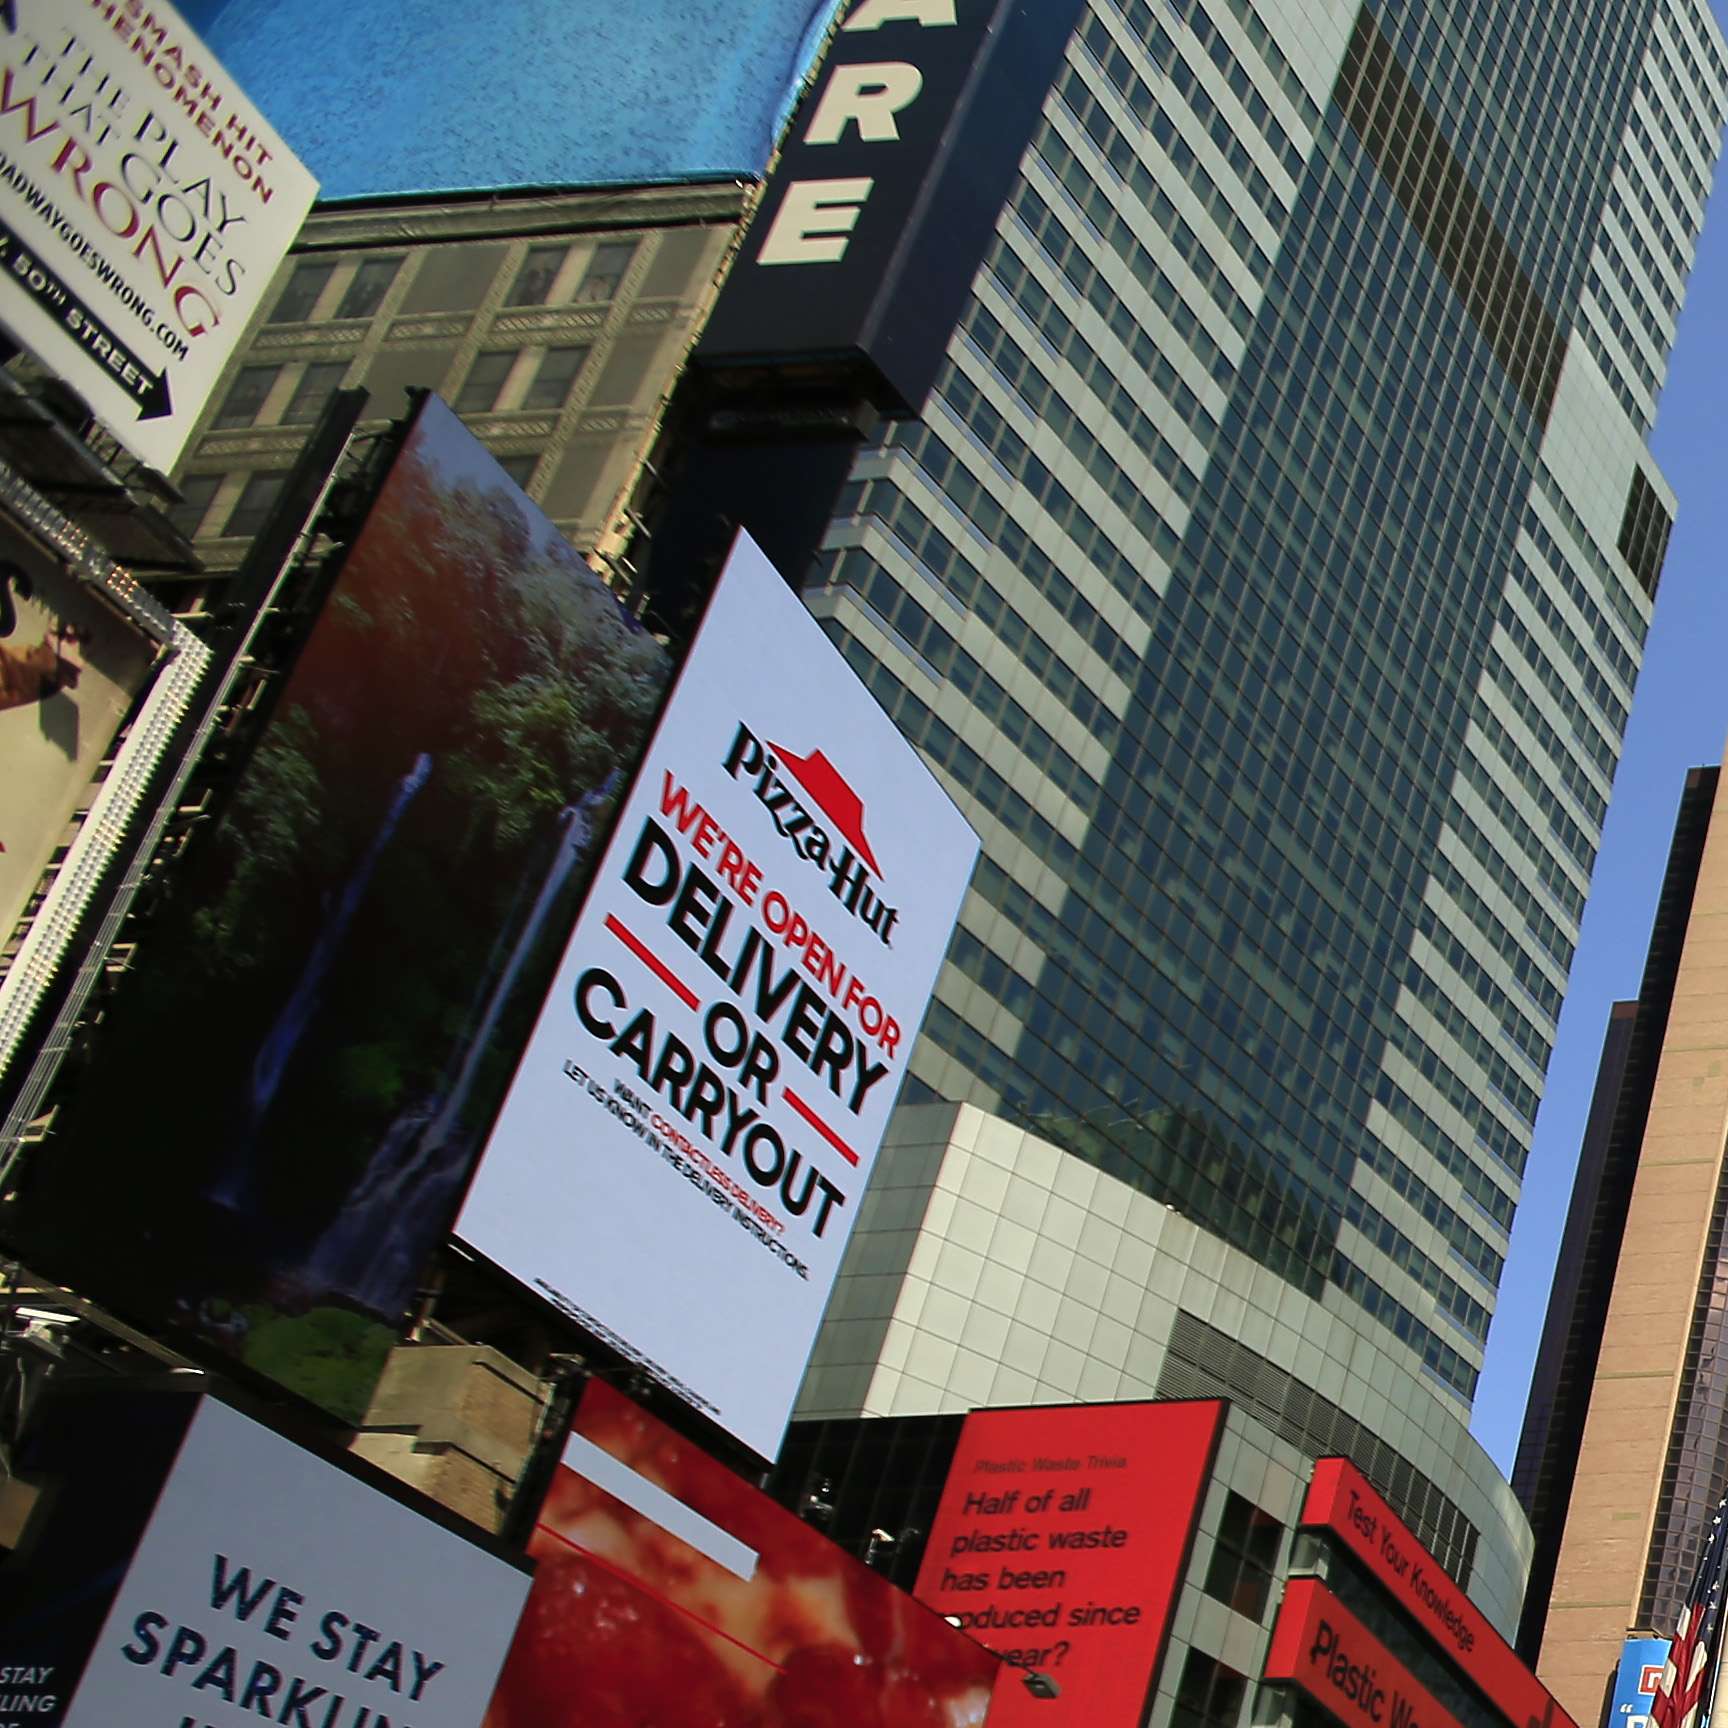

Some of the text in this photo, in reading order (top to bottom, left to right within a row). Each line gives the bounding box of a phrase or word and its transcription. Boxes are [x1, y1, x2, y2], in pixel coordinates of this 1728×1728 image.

[23, 33, 122, 146] THAT
[60, 25, 131, 112] THE
[125, 0, 273, 165] SMASH HIT
[0, 66, 221, 337] WRONG
[120, 152, 246, 295] GOES
[134, 110, 247, 233] PLAY
[65, 307, 154, 395] STREET
[721, 720, 900, 949] Pizza Hut
[622, 815, 889, 1115] DELIVERY
[659, 769, 902, 1060] WE'RE OPEN FOR
[574, 967, 846, 1238] CARRYOUT
[703, 1001, 779, 1107] OR
[586, 1079, 609, 1104] US
[606, 1097, 646, 1139] KNOW
[961, 1487, 1092, 1517] Half of all
[974, 1455, 1128, 1475] Plastic Waste Trivia
[940, 1567, 1065, 1591] has been
[950, 1525, 1129, 1559] plastic waste
[1347, 1491, 1475, 1654] Test Your Knowledge
[209, 1554, 445, 1702] WE STAY
[1067, 1601, 1142, 1627] since
[0, 1694, 58, 1713] LING
[1309, 1619, 1383, 1722] Plastic
